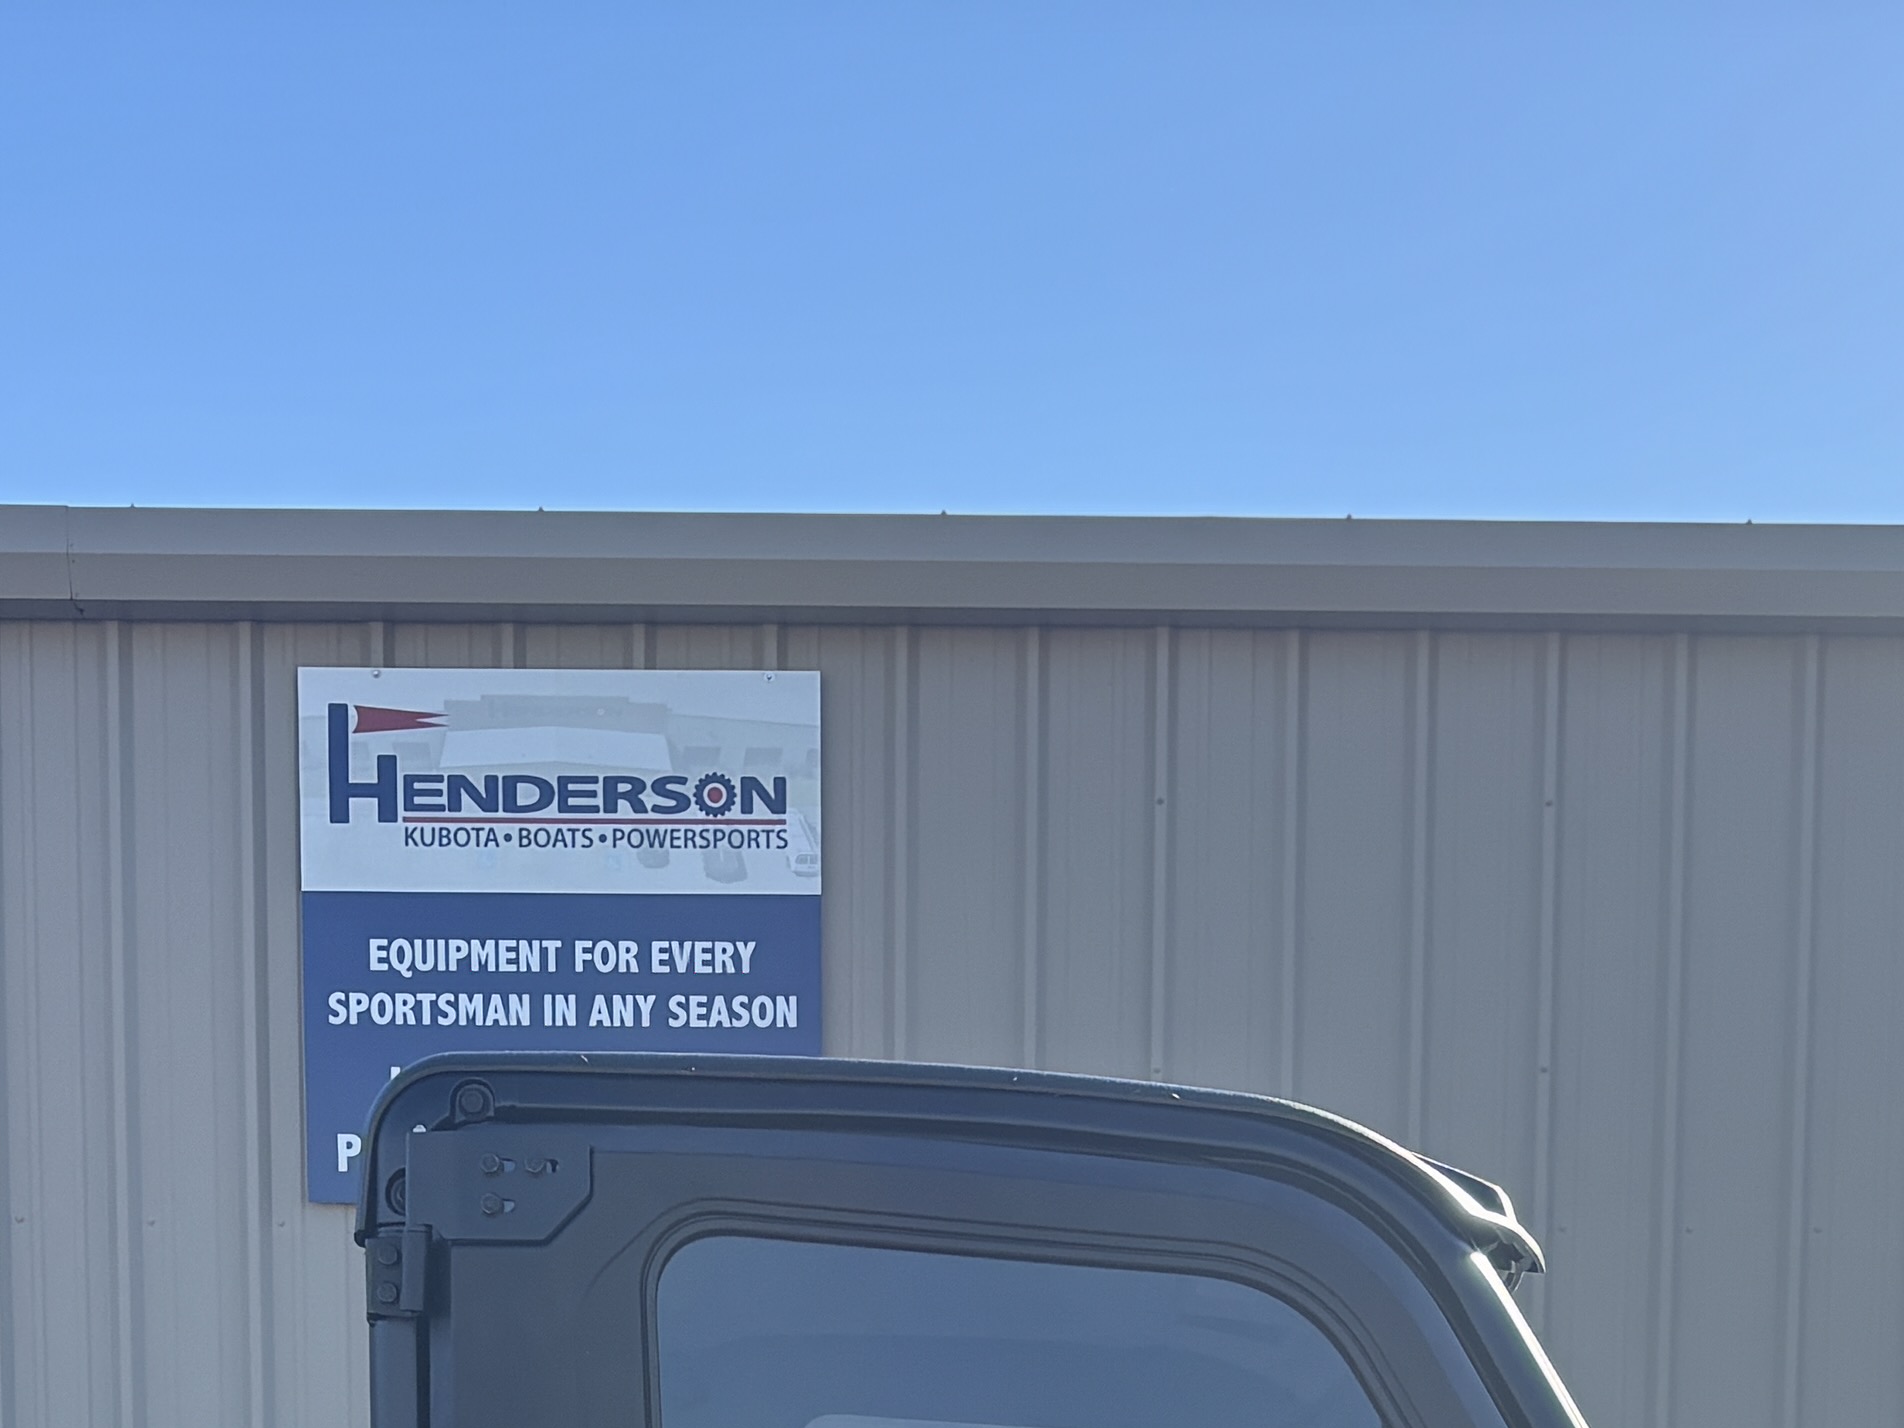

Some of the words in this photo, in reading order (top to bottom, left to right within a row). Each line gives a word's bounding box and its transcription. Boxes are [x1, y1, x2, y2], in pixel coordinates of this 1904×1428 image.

[327, 702, 788, 824] HENDERSON
[403, 827, 500, 848] KUBOTA
[517, 828, 594, 849] BOATS
[612, 828, 789, 850] POWERSPORTS
[368, 938, 562, 978] EQUIPMENT
[574, 940, 640, 974] FOR
[650, 941, 756, 975] EVERY
[327, 991, 531, 1027] SPORTSMAN
[543, 993, 577, 1027] IN
[588, 994, 656, 1028] ANY
[667, 995, 798, 1028] SEASON
